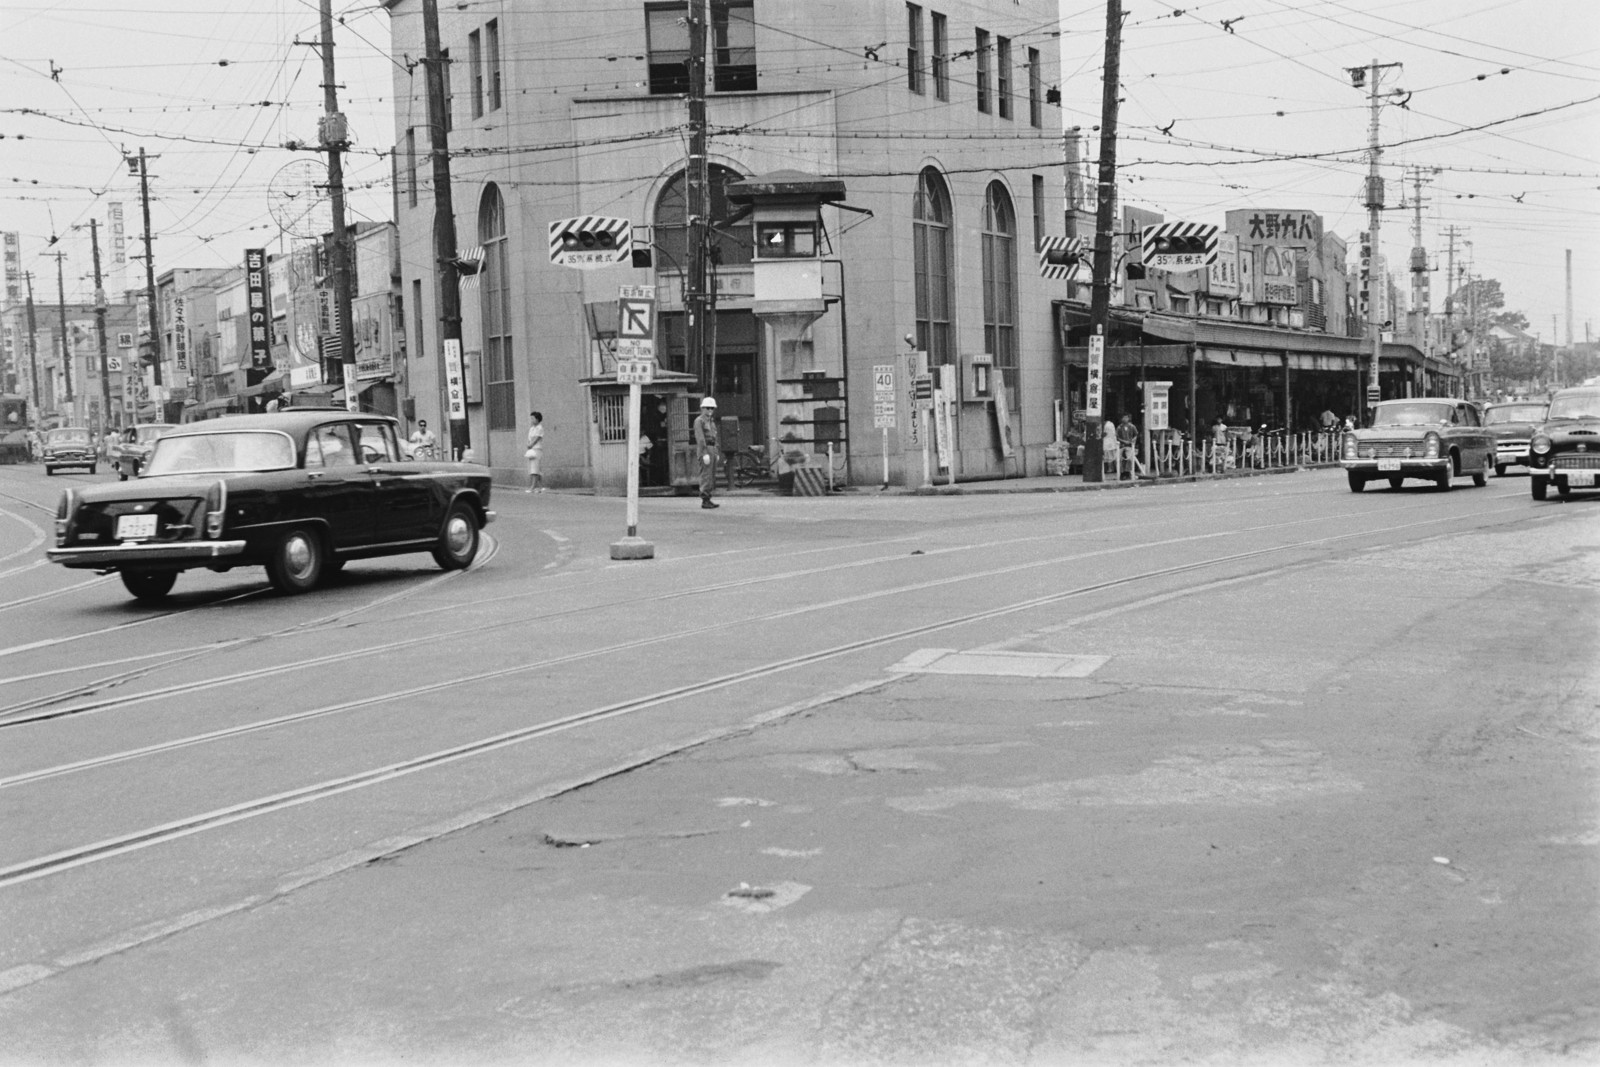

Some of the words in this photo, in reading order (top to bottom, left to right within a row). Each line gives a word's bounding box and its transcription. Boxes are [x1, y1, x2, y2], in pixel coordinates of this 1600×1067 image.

[248, 254, 267, 364] 吉田屋の菓子
[877, 374, 892, 386] 40
